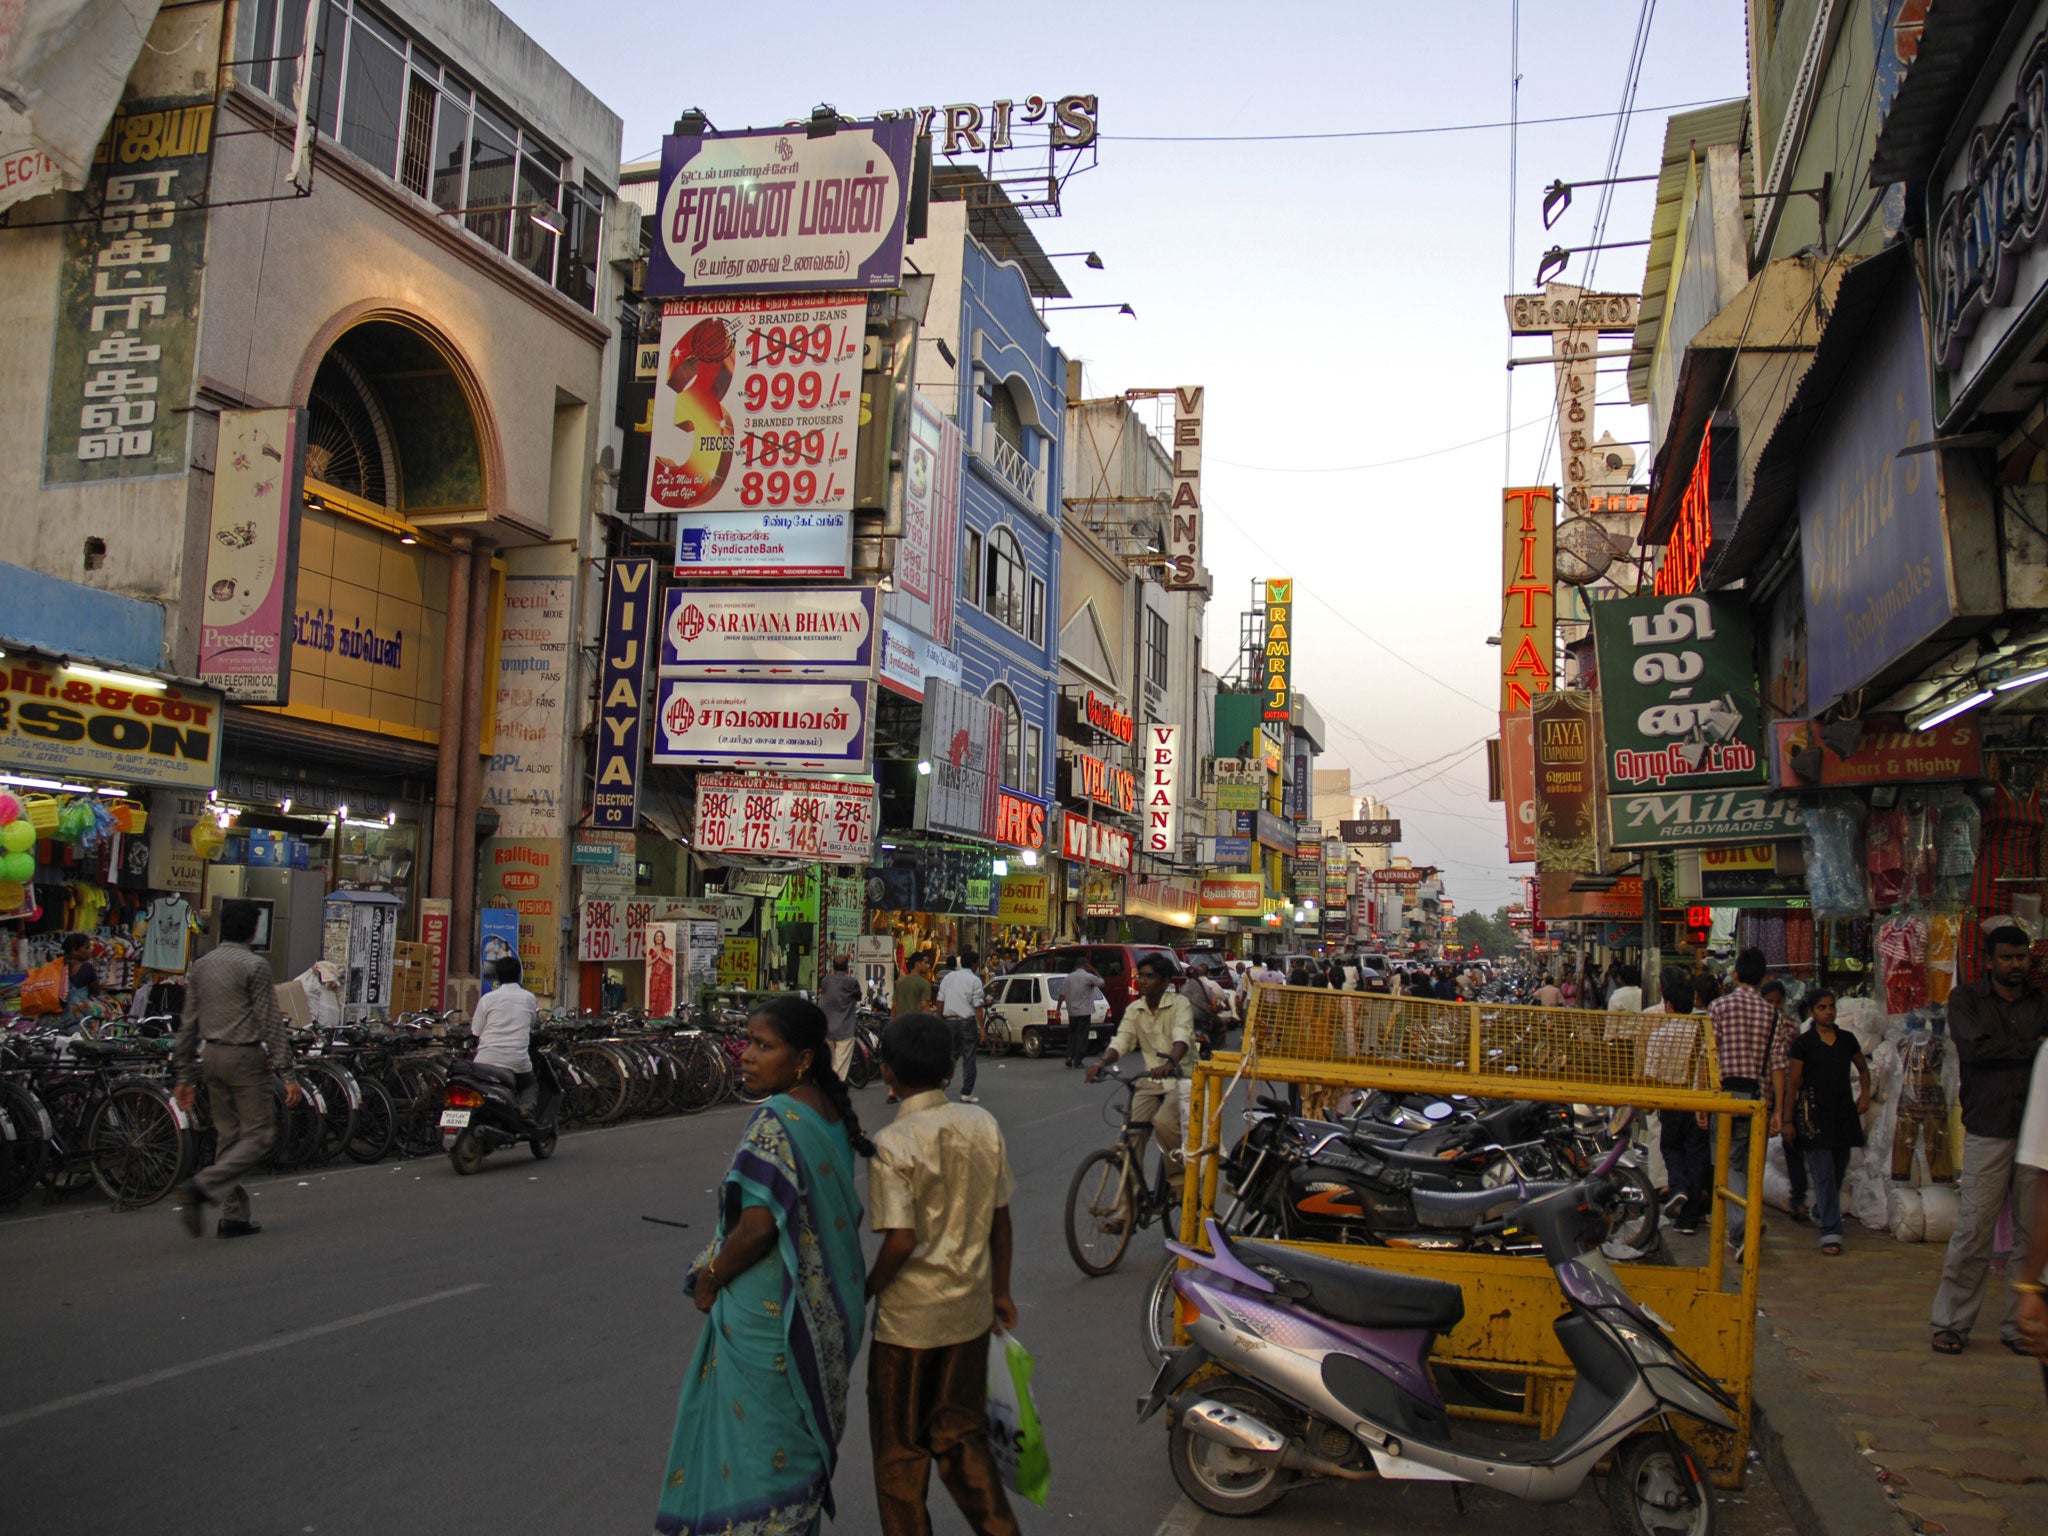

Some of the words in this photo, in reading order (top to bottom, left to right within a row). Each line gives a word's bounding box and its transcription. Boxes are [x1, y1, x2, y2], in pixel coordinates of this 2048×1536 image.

[672, 181, 796, 257] சரவண
[798, 160, 889, 236] பவன்
[663, 302, 695, 316] DIRECT
[698, 299, 736, 314] FACTORY
[739, 298, 761, 312] SALE
[749, 314, 756, 325] 3
[758, 313, 809, 325] BRANDED
[813, 309, 848, 321] JEANS
[745, 418, 750, 427] 3
[752, 417, 794, 427] BRANDED
[796, 415, 844, 425] TROUSERS
[700, 436, 735, 451] PIECES
[1172, 387, 1203, 584] VELAN'S
[711, 543, 784, 556] SyndicateBank
[1505, 489, 1552, 712] TITAN
[542, 610, 564, 618] MIXIE
[707, 613, 791, 633] SARAVANA
[795, 612, 862, 633] BHAVAN
[204, 628, 276, 652] Prestige
[540, 643, 566, 652] COOKER
[1266, 607, 1290, 708] RAMRAJ
[224, 675, 259, 687] ELECTRIC
[541, 673, 560, 681] FANS
[600, 563, 649, 785] VIJAYA
[536, 698, 556, 707] FANS
[1264, 711, 1289, 719] COTTON
[18, 702, 210, 763] SON
[1544, 722, 1583, 746] JAYA
[87, 749, 113, 761] ITEMS
[125, 753, 145, 764] GIFT
[147, 757, 189, 772] ARTICLES
[1543, 746, 1584, 761] EMPORIUM
[490, 754, 523, 772] BPL
[1906, 757, 1962, 776] Nighty
[766, 779, 784, 789] SALE
[1080, 753, 1134, 813] VELAN'S
[1150, 728, 1174, 850] VELANS
[252, 778, 358, 809] ELECTRIC
[597, 794, 634, 806] ELECTRIC
[606, 809, 622, 821] CO
[1660, 820, 1774, 837] READYMADES
[495, 846, 549, 867] Rallifan
[576, 845, 612, 854] SIEMENS
[505, 876, 537, 886] POLAR
[518, 901, 553, 914] USHA
